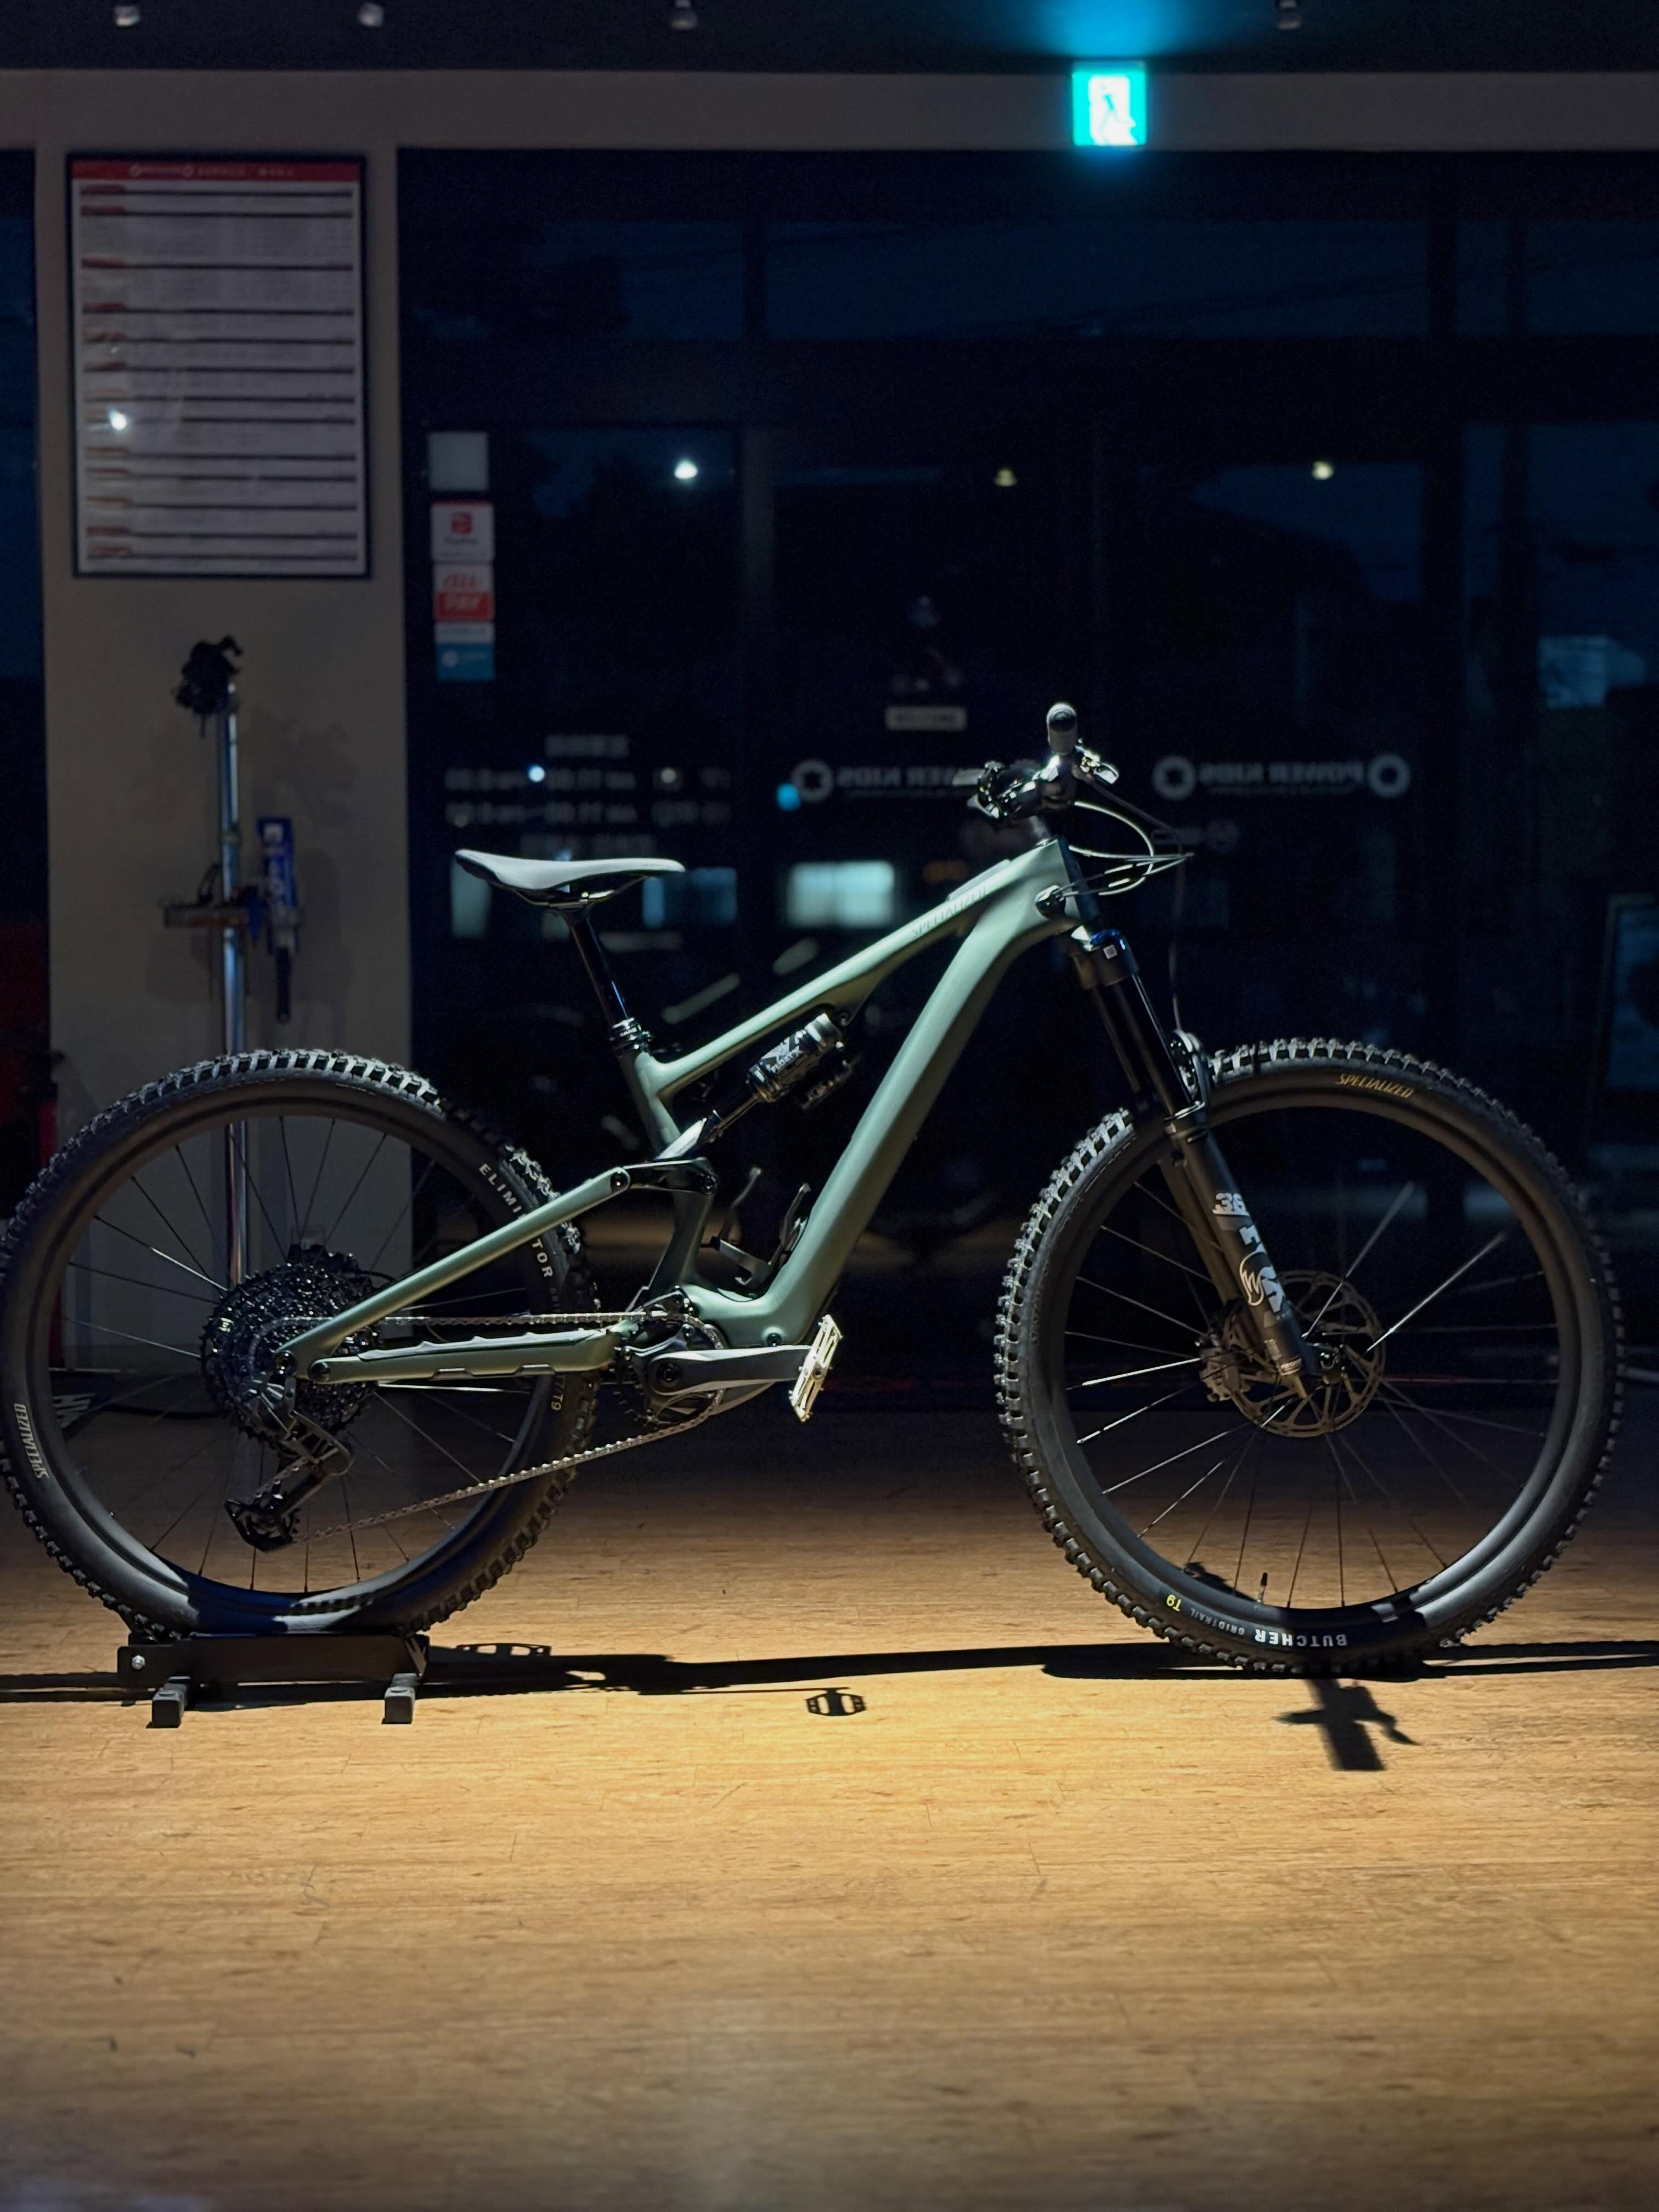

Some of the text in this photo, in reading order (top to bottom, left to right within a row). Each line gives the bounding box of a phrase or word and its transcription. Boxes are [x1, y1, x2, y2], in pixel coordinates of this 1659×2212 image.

[1335, 1073, 1414, 1099] SPECIALIZED
[478, 1163, 554, 1278] ELIMITOR
[14, 1403, 49, 1479] SPECIALIZED
[1165, 1594, 1181, 1612] T9
[1254, 1628, 1347, 1647] BUTCHER
